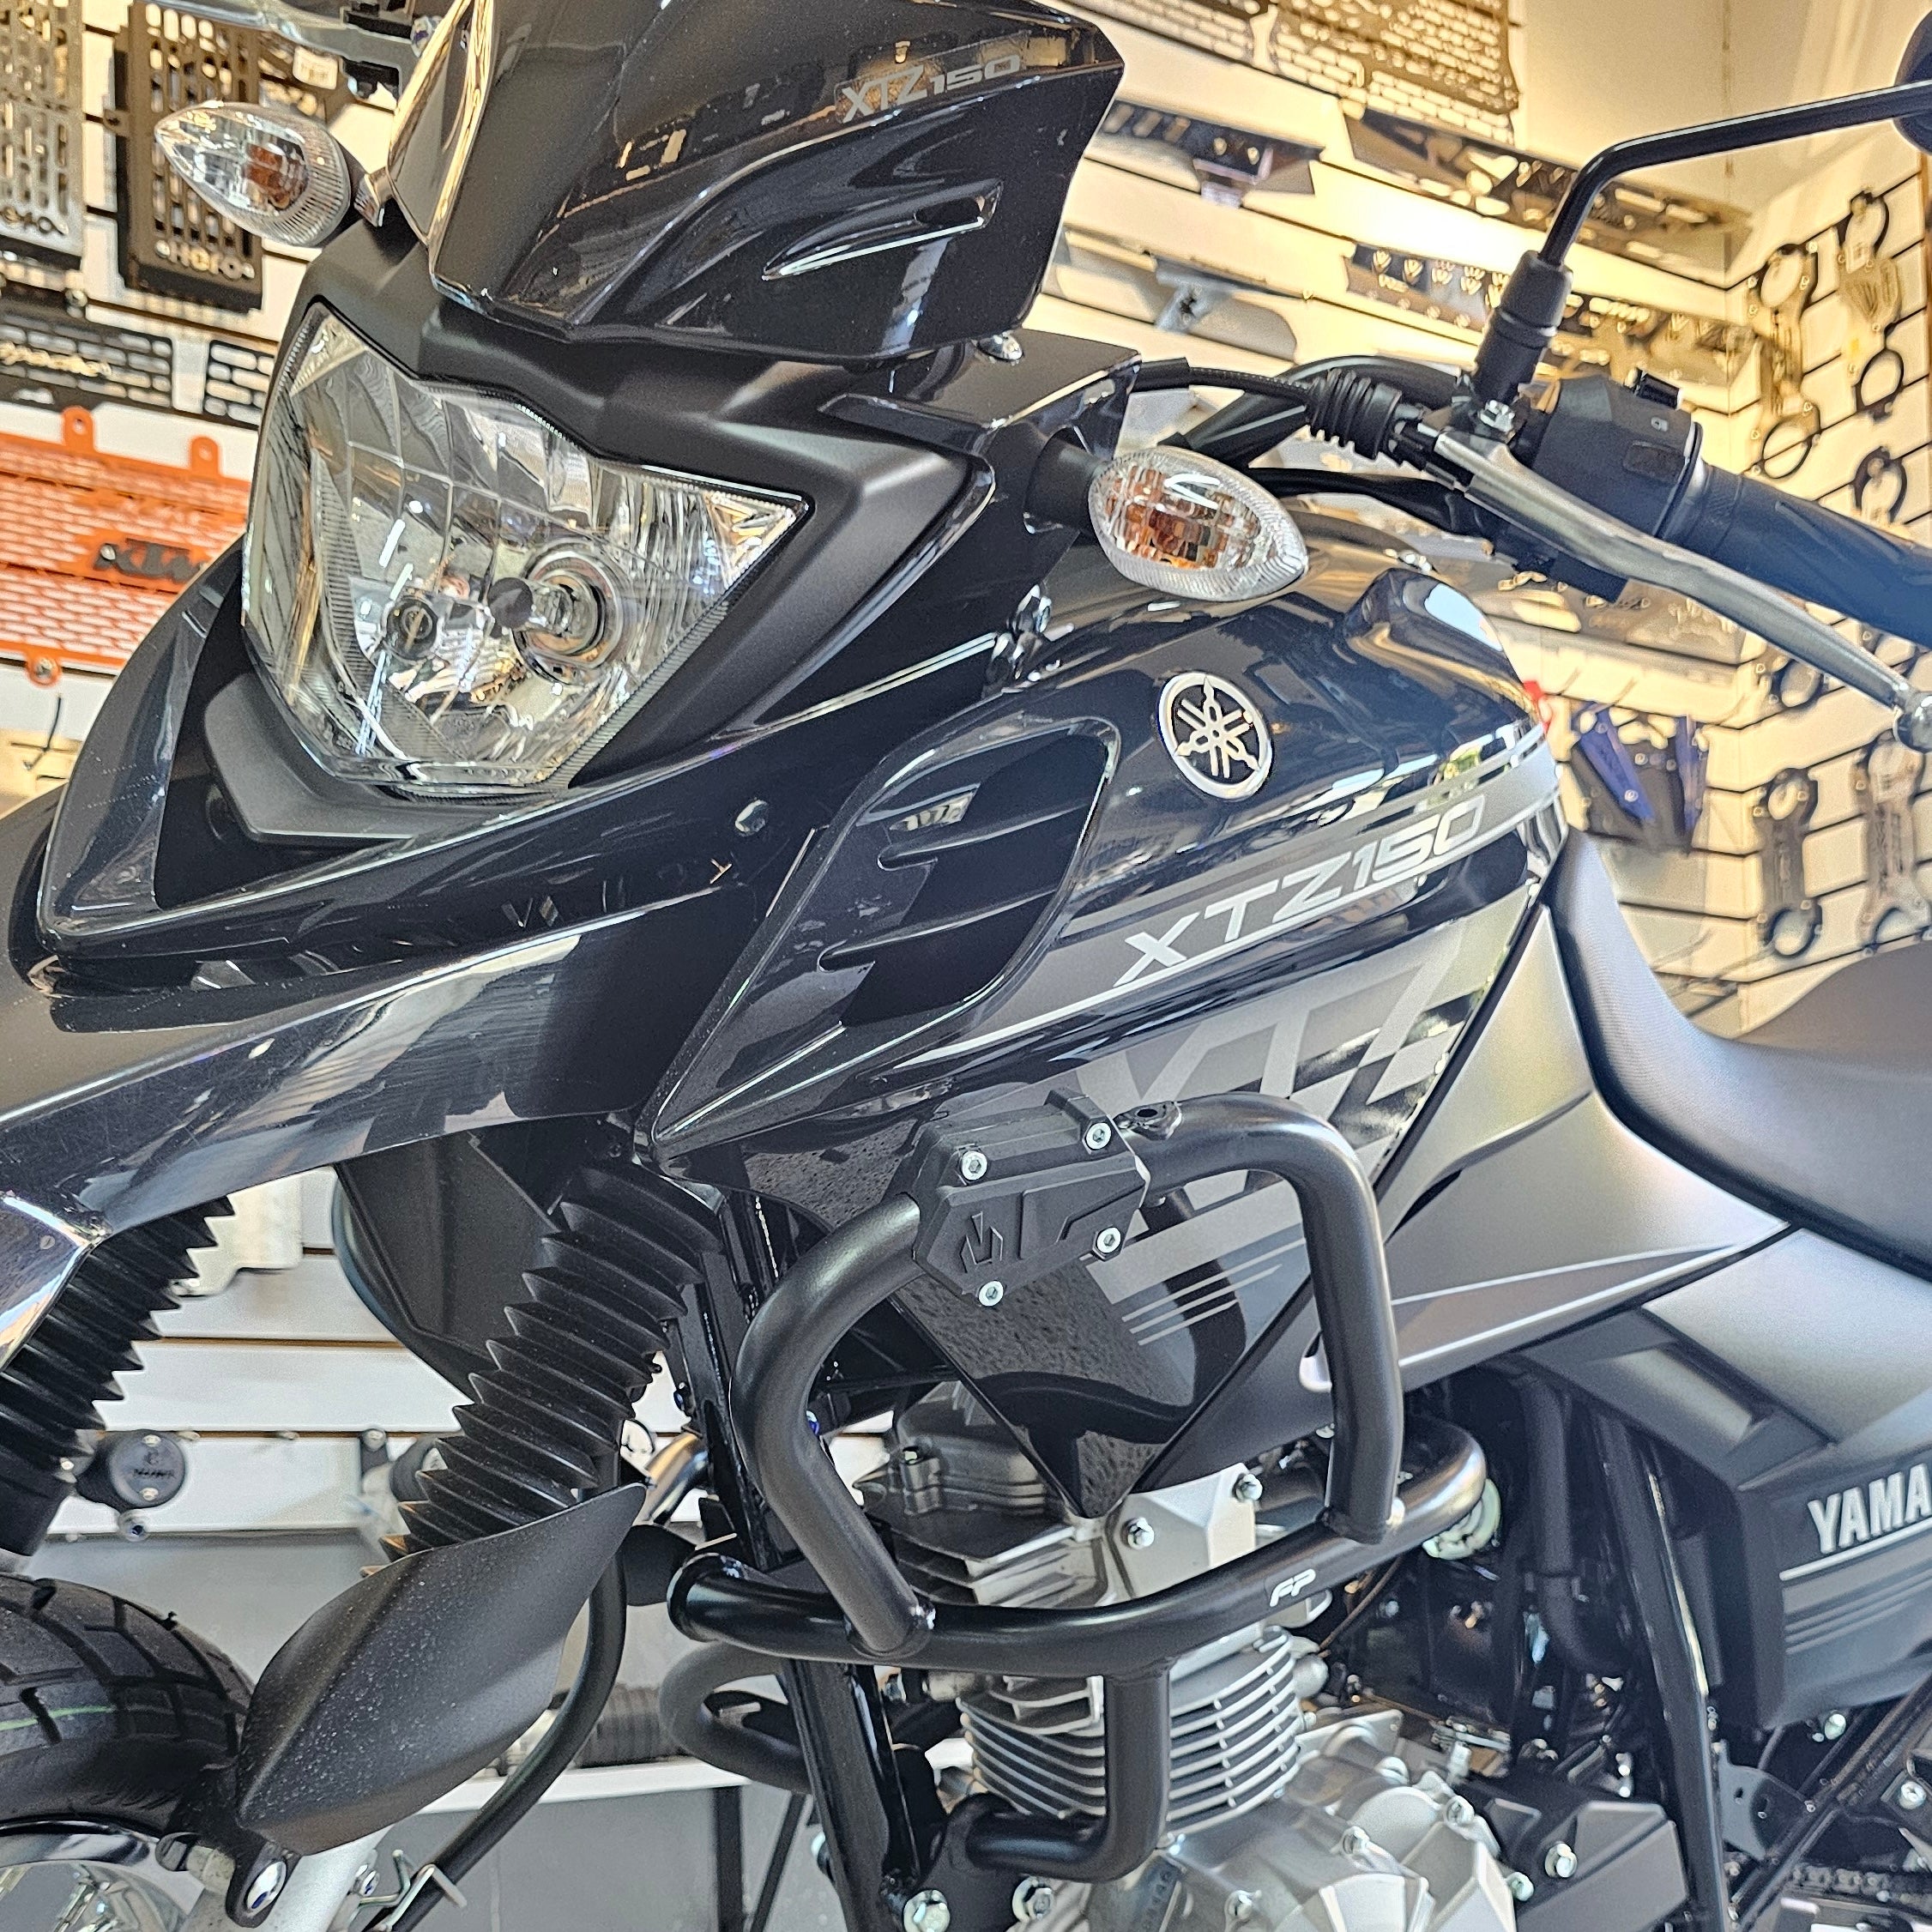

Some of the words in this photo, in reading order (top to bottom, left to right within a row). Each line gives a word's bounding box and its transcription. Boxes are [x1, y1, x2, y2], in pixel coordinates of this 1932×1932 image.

[842, 54, 1021, 124] XTZ150
[1113, 794, 1485, 987] XTZ150
[1807, 1462, 1932, 1554] YAMA
